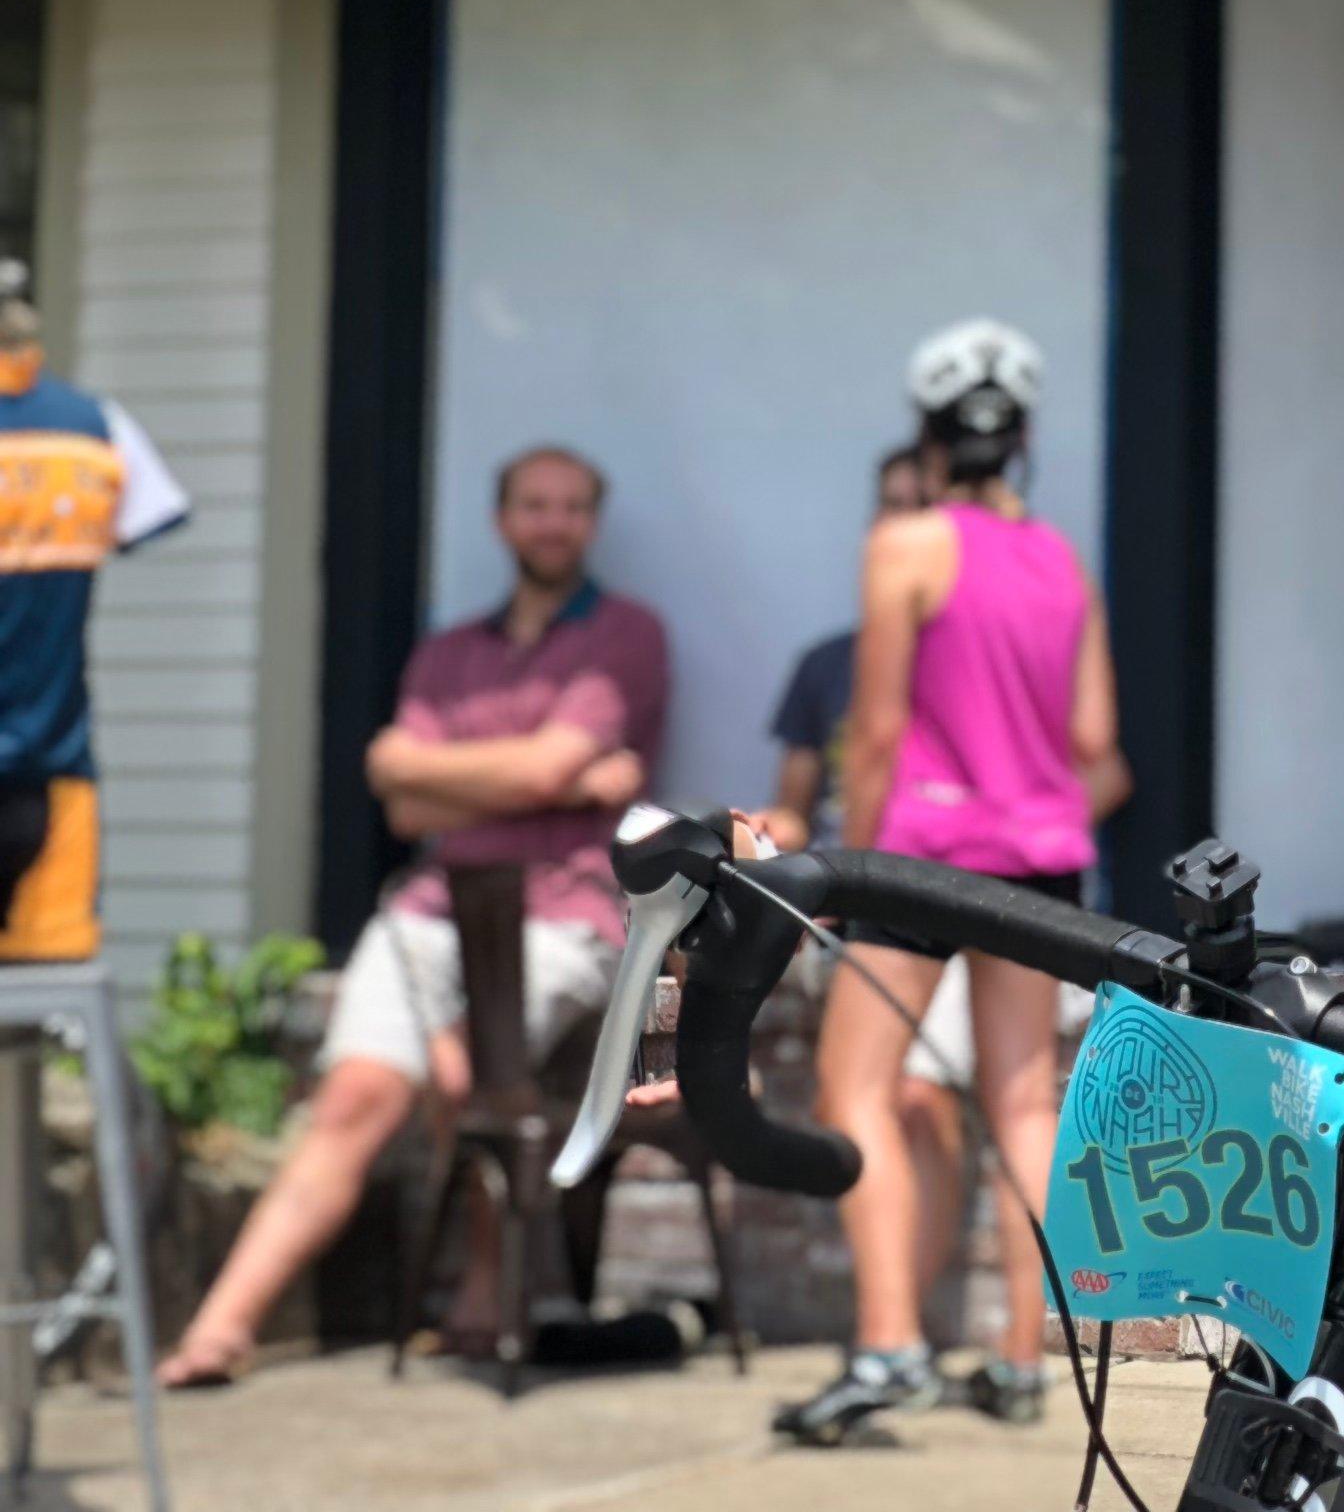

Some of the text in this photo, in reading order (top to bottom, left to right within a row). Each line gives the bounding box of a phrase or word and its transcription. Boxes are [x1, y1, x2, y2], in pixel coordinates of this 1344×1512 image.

[1267, 1046, 1325, 1085] WALK
[1282, 1068, 1320, 1104] BIKE
[1271, 1081, 1315, 1122] NASH
[1066, 1129, 1322, 1254] 1526
[1246, 1288, 1296, 1339] CIVIC
